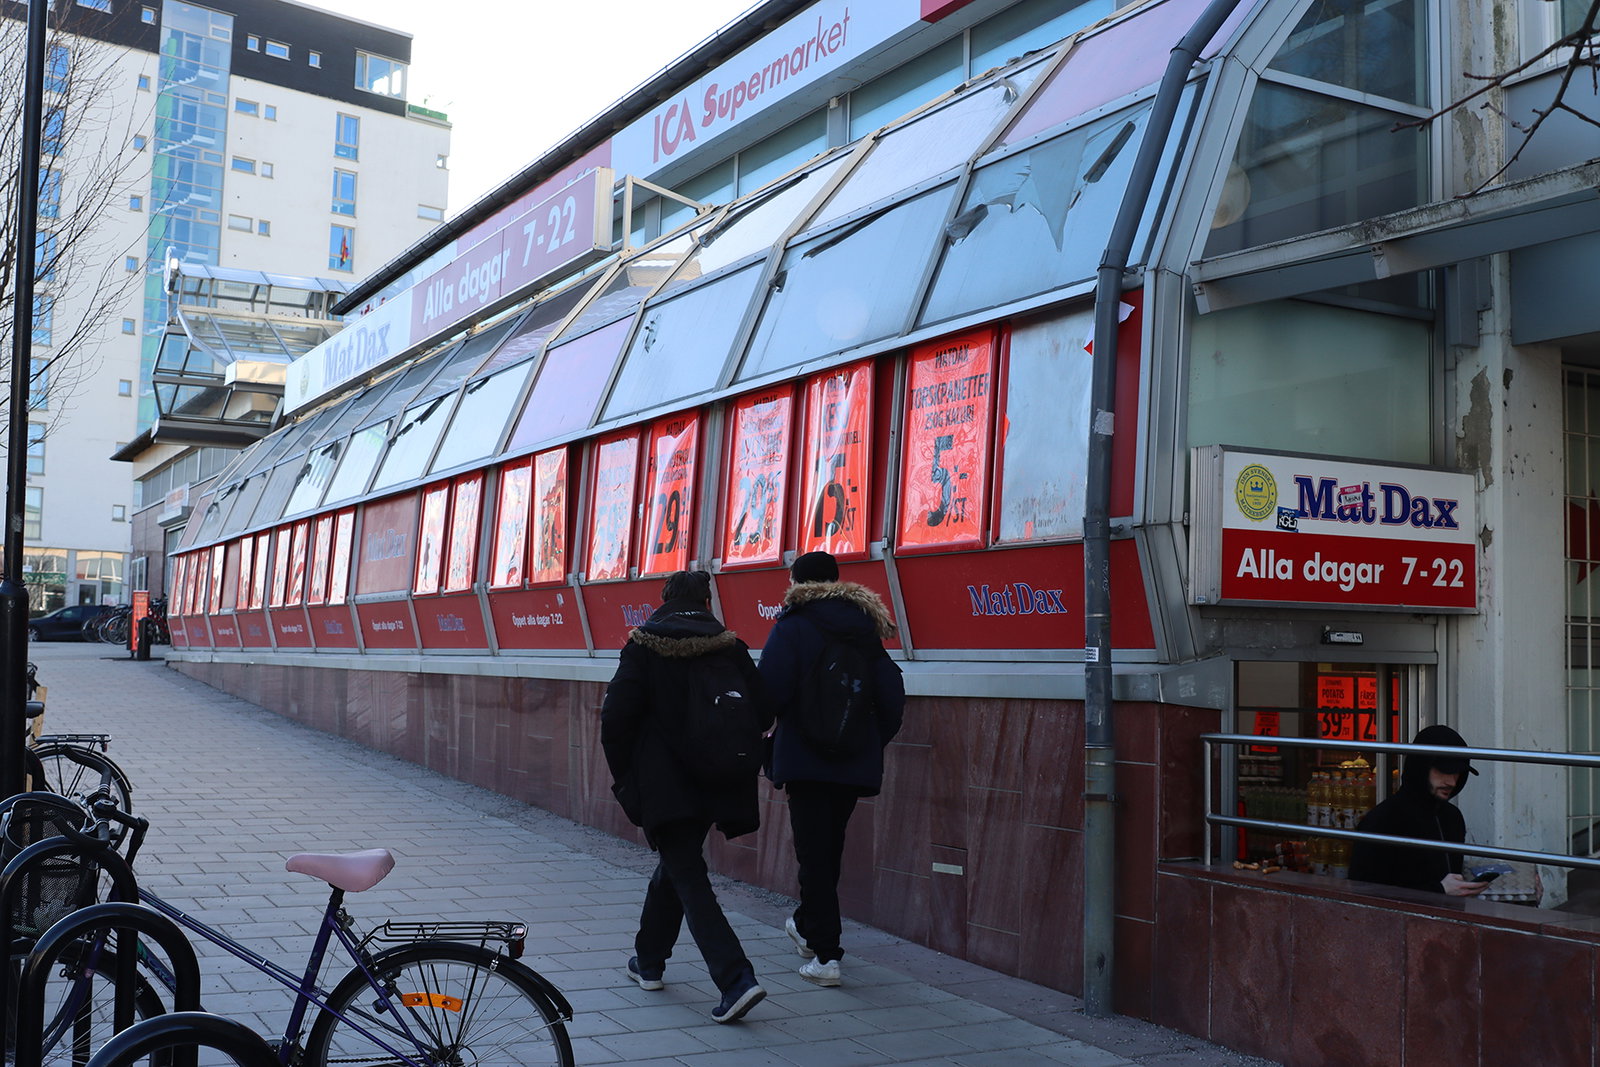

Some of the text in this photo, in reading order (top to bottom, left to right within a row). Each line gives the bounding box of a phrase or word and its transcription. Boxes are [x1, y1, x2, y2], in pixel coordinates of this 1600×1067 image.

[653, 7, 850, 164] ICA Supermarket
[422, 195, 577, 325] Alla dagar 7-22
[935, 344, 970, 369] MATDAX
[1236, 547, 1465, 592] Alla dagar 7-22
[758, 600, 783, 621] Öppet
[1322, 688, 1345, 700] POTATIS
